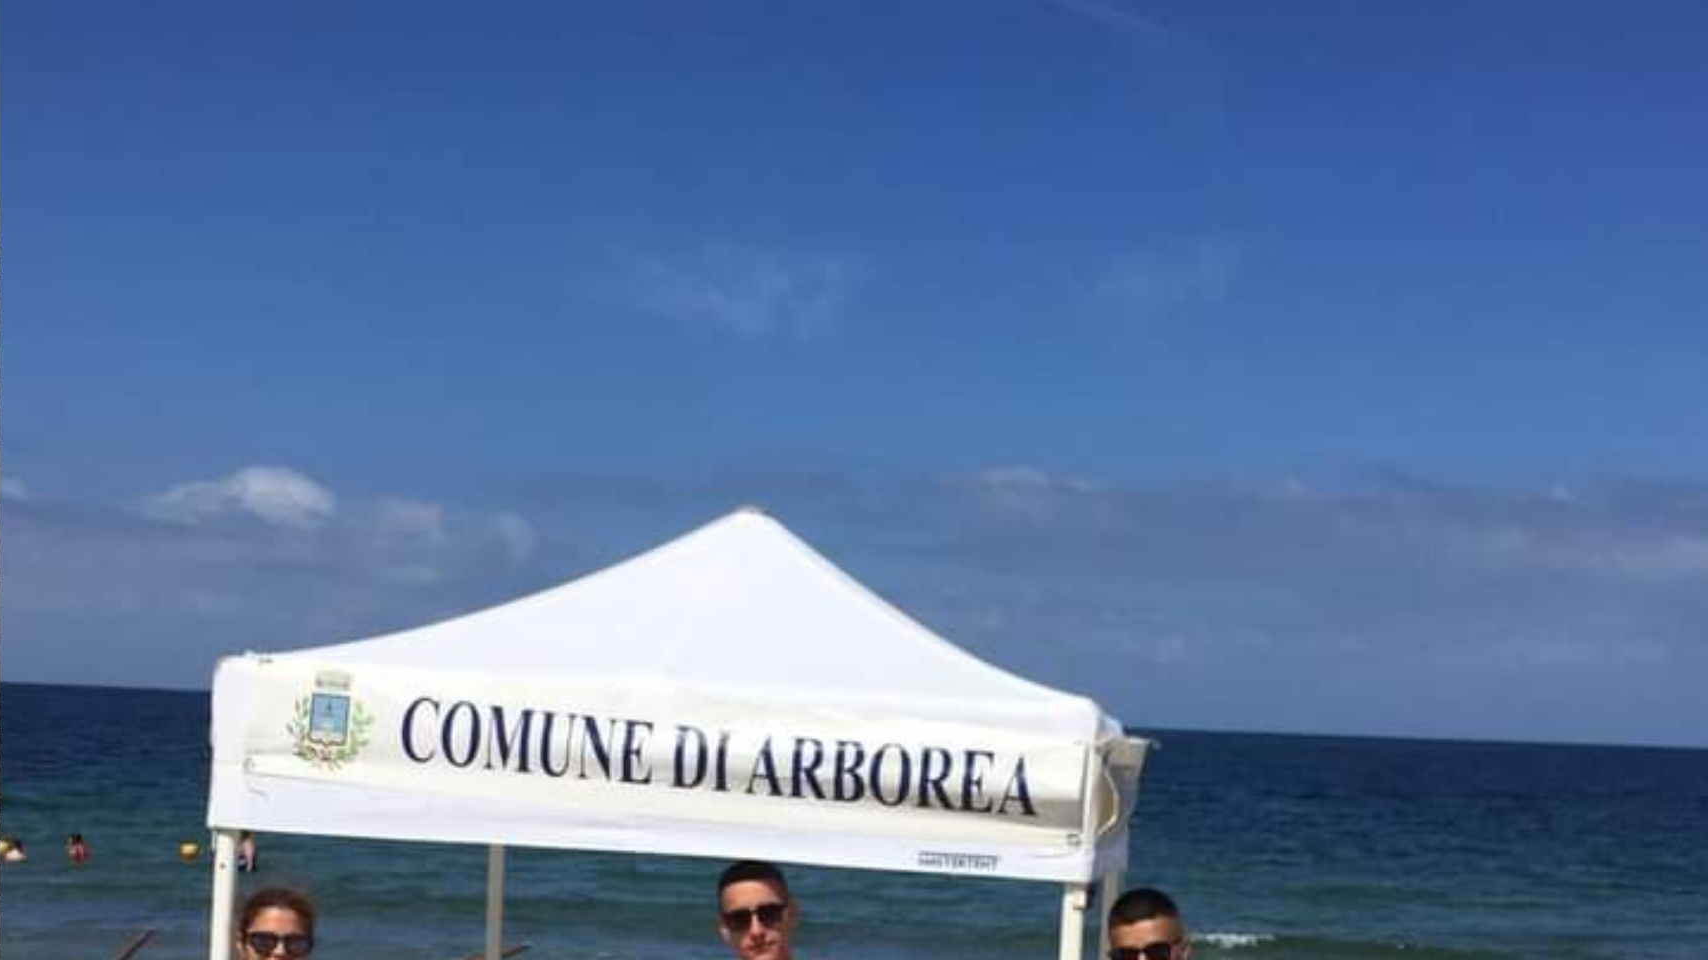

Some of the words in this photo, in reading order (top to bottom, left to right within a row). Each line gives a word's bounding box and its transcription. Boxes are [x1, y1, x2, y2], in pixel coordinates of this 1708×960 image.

[401, 697, 654, 785] COMUNE
[672, 725, 731, 793] DI
[745, 736, 1039, 817] ARBOREA
